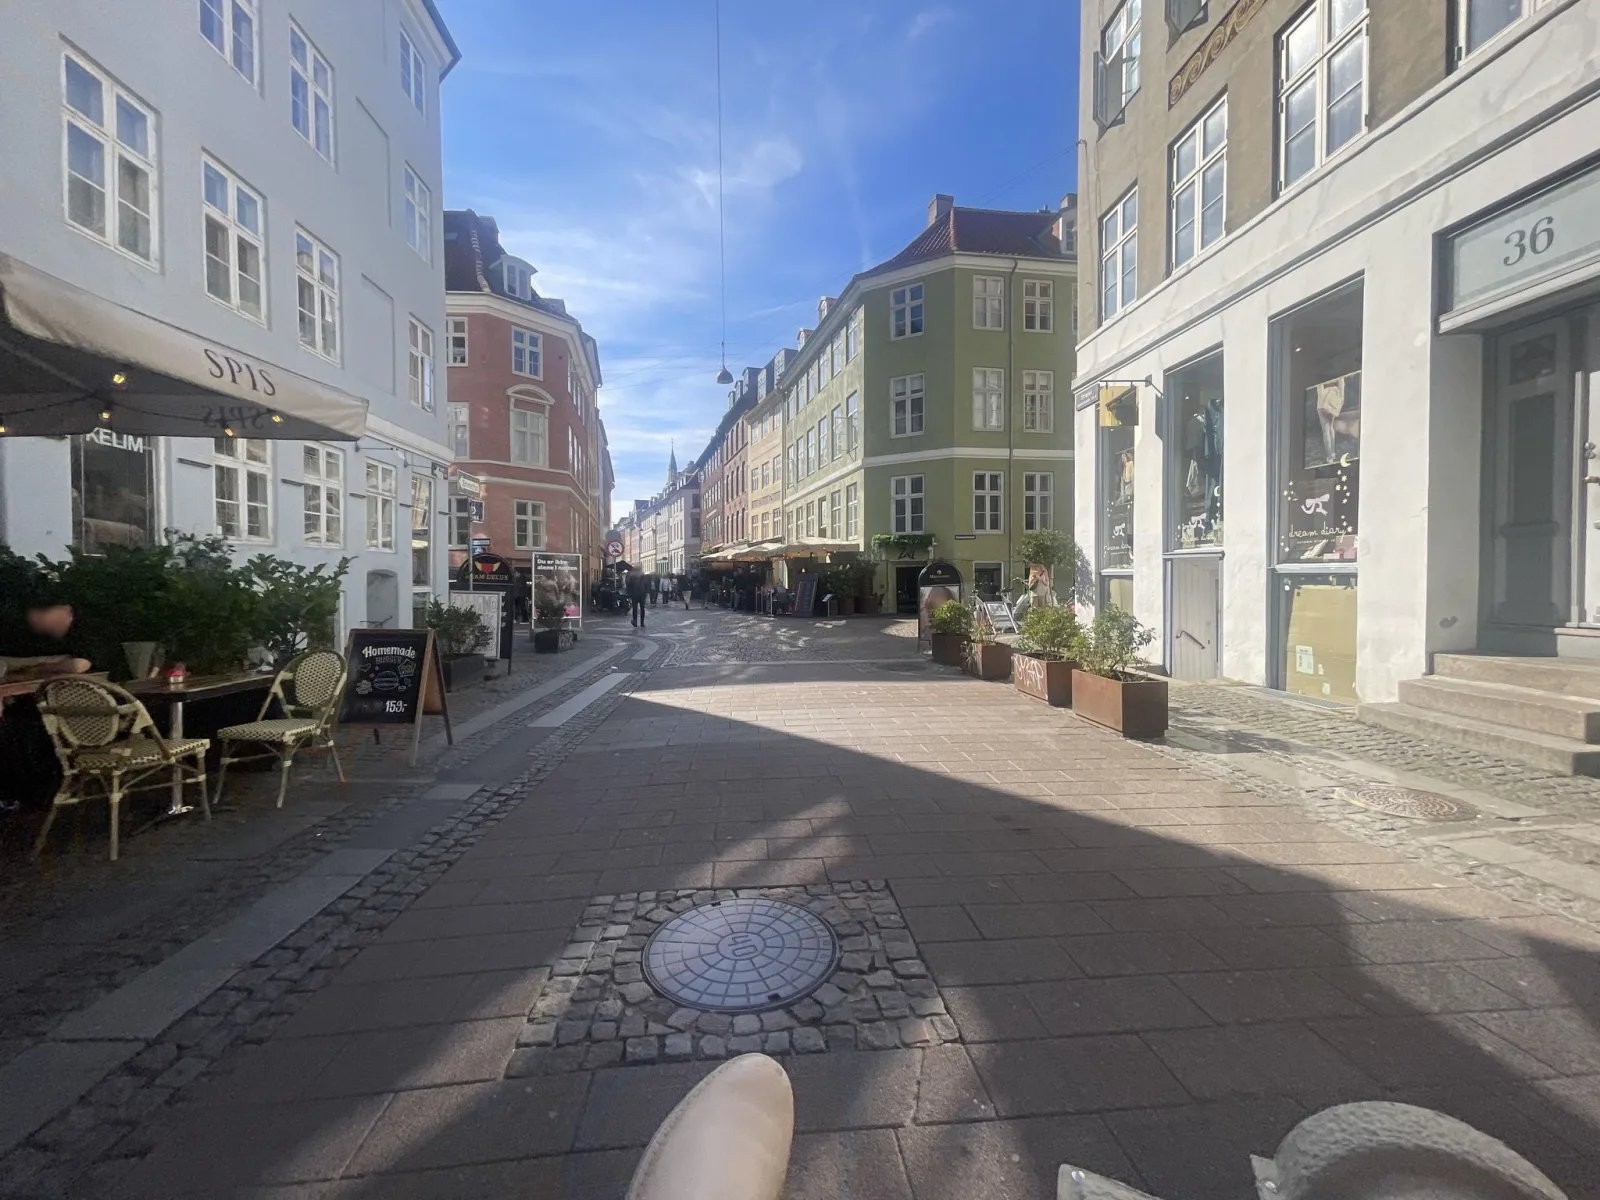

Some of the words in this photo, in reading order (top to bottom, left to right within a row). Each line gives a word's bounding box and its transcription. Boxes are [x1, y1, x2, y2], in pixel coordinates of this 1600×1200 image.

[1503, 216, 1554, 267] 36
[204, 348, 276, 396] SPIS
[86, 427, 144, 453] KELIM
[1289, 524, 1318, 538] dream
[1320, 520, 1347, 544] diary
[362, 646, 416, 659] Homemade
